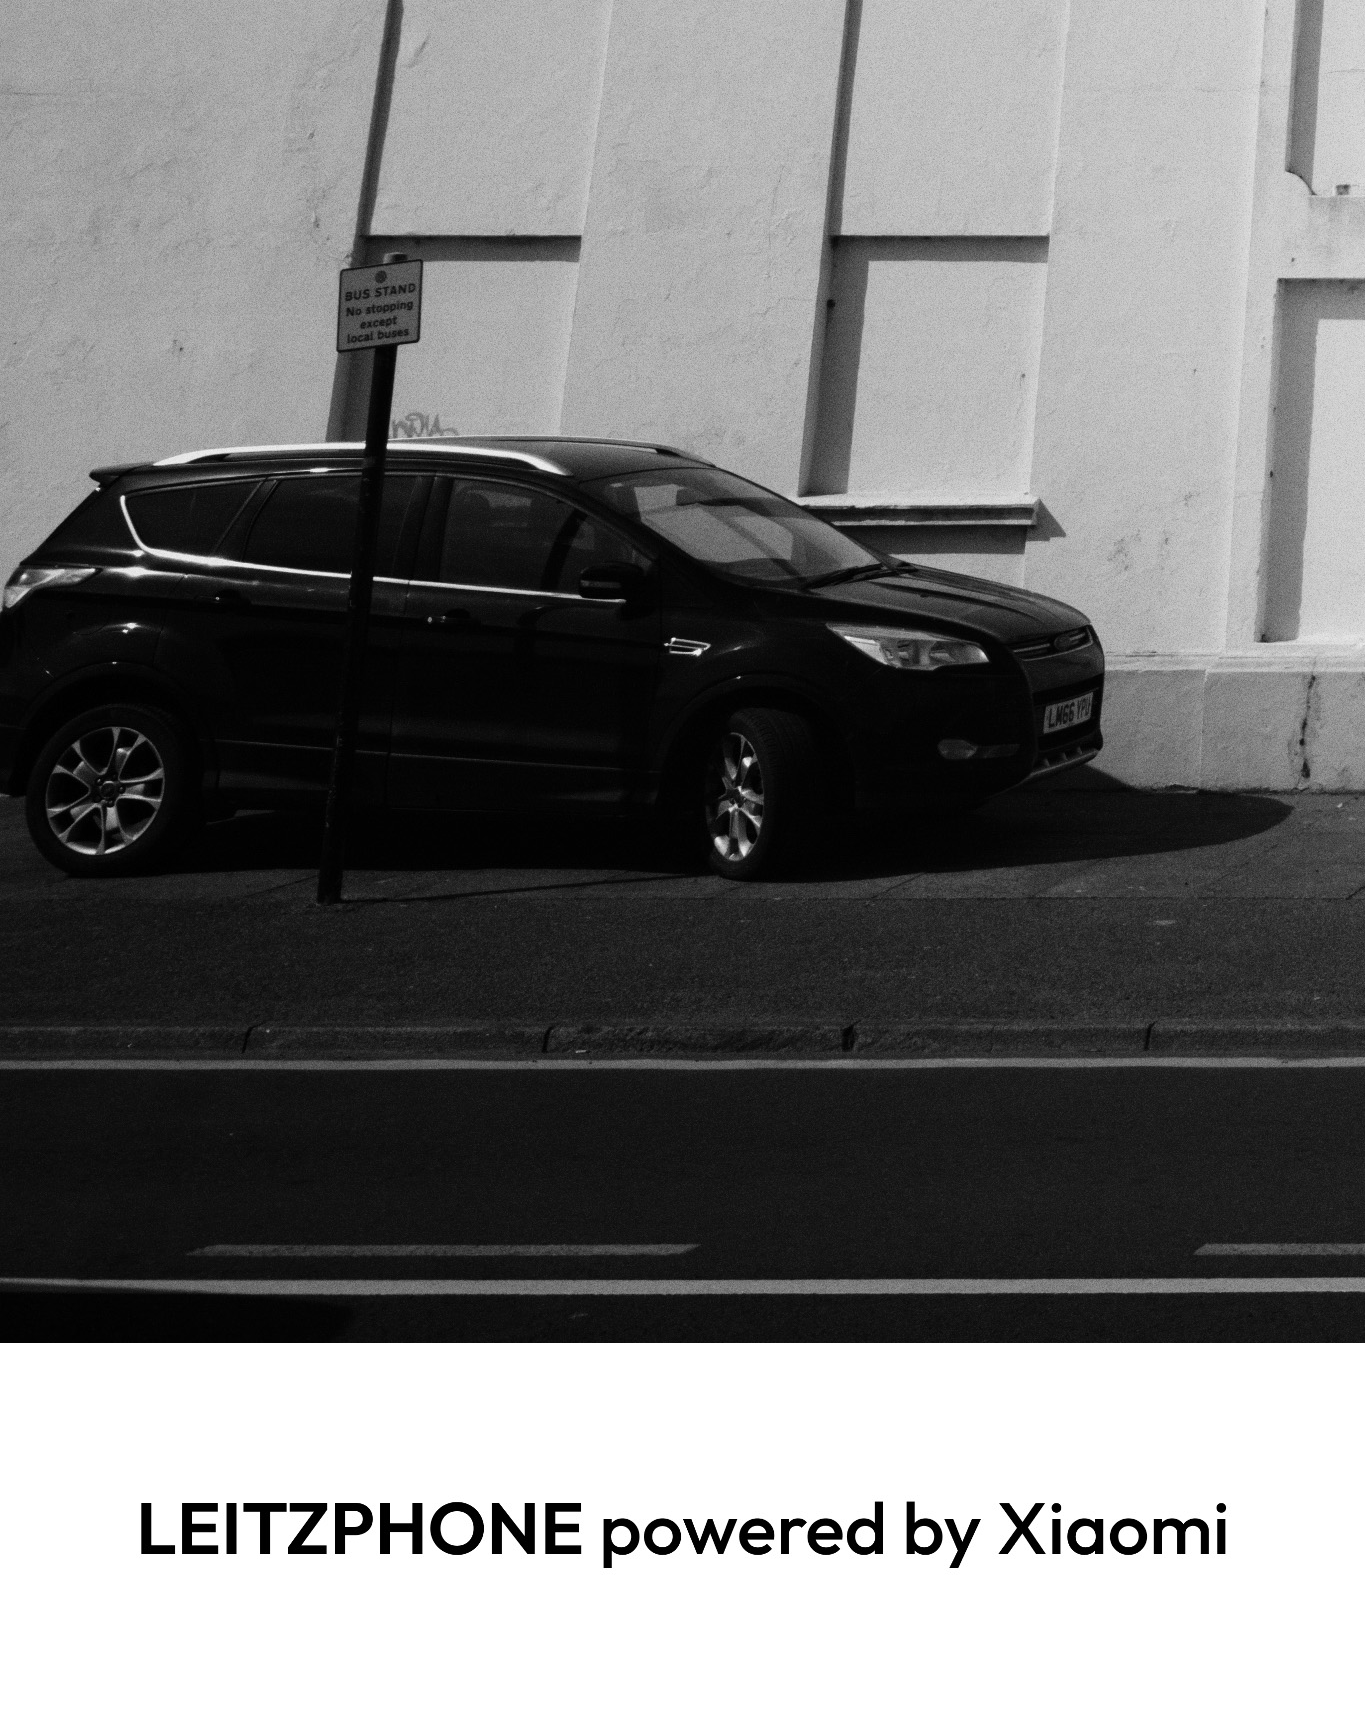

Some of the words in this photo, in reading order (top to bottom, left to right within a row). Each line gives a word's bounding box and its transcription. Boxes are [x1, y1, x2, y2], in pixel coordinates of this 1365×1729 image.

[344, 289, 370, 302] BUS
[374, 283, 416, 298] STAND
[345, 306, 362, 317] No
[366, 300, 414, 314] stopping
[360, 316, 398, 330] except
[346, 332, 374, 344] local
[377, 328, 410, 340] buses
[1048, 701, 1075, 728] LM66
